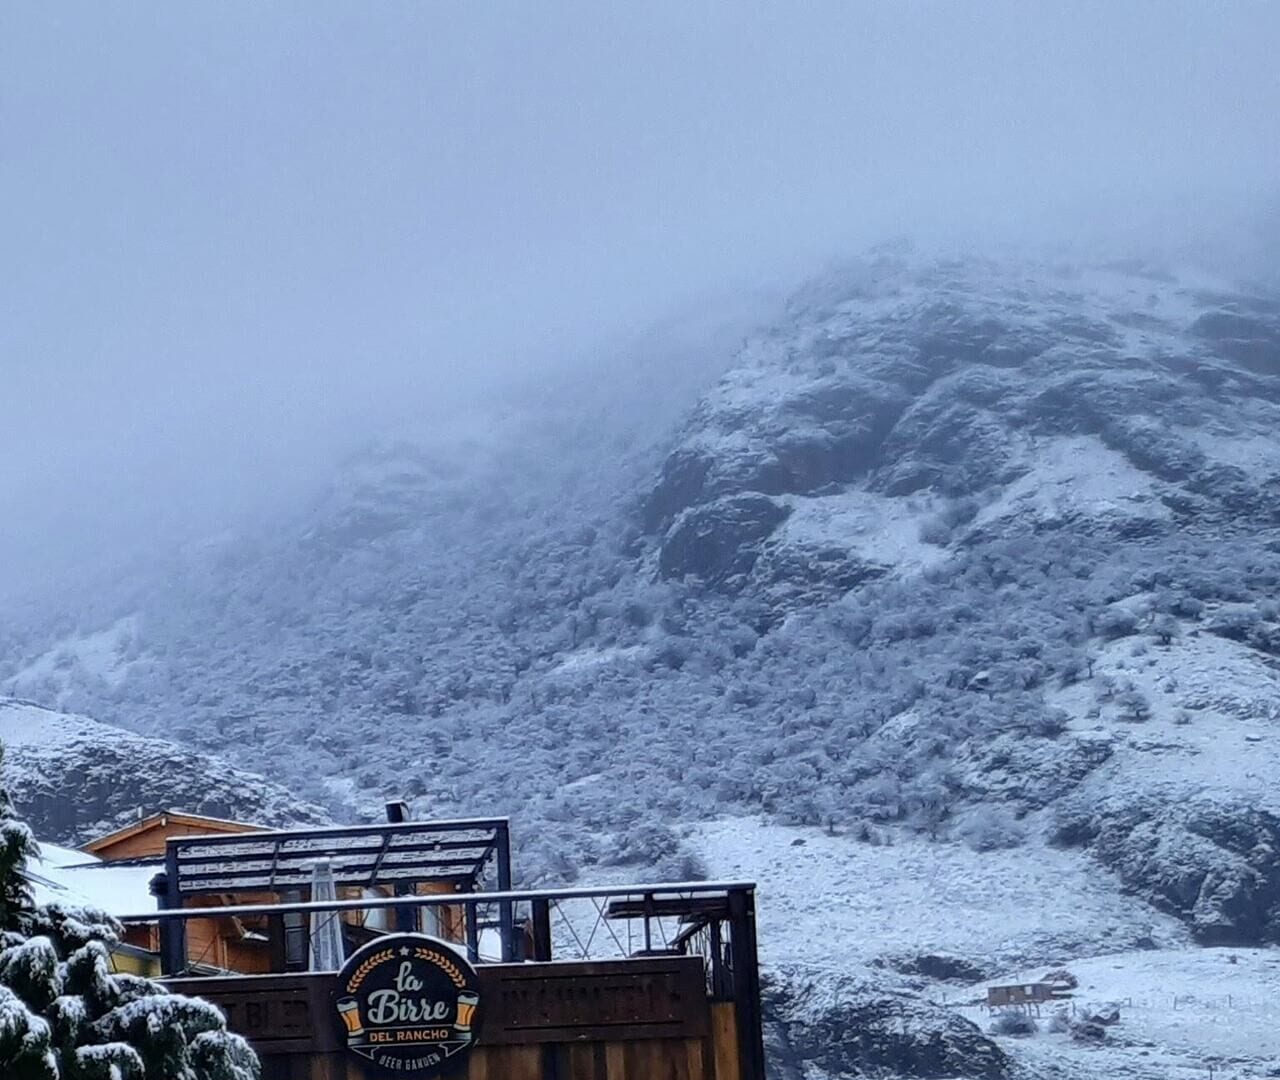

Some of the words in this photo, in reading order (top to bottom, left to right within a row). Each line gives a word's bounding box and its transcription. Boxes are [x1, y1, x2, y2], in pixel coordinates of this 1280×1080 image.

[367, 989, 449, 1024] Birre
[369, 1032, 393, 1042] DEL
[397, 1029, 449, 1040] RANCHO
[379, 1055, 402, 1070] BEER
